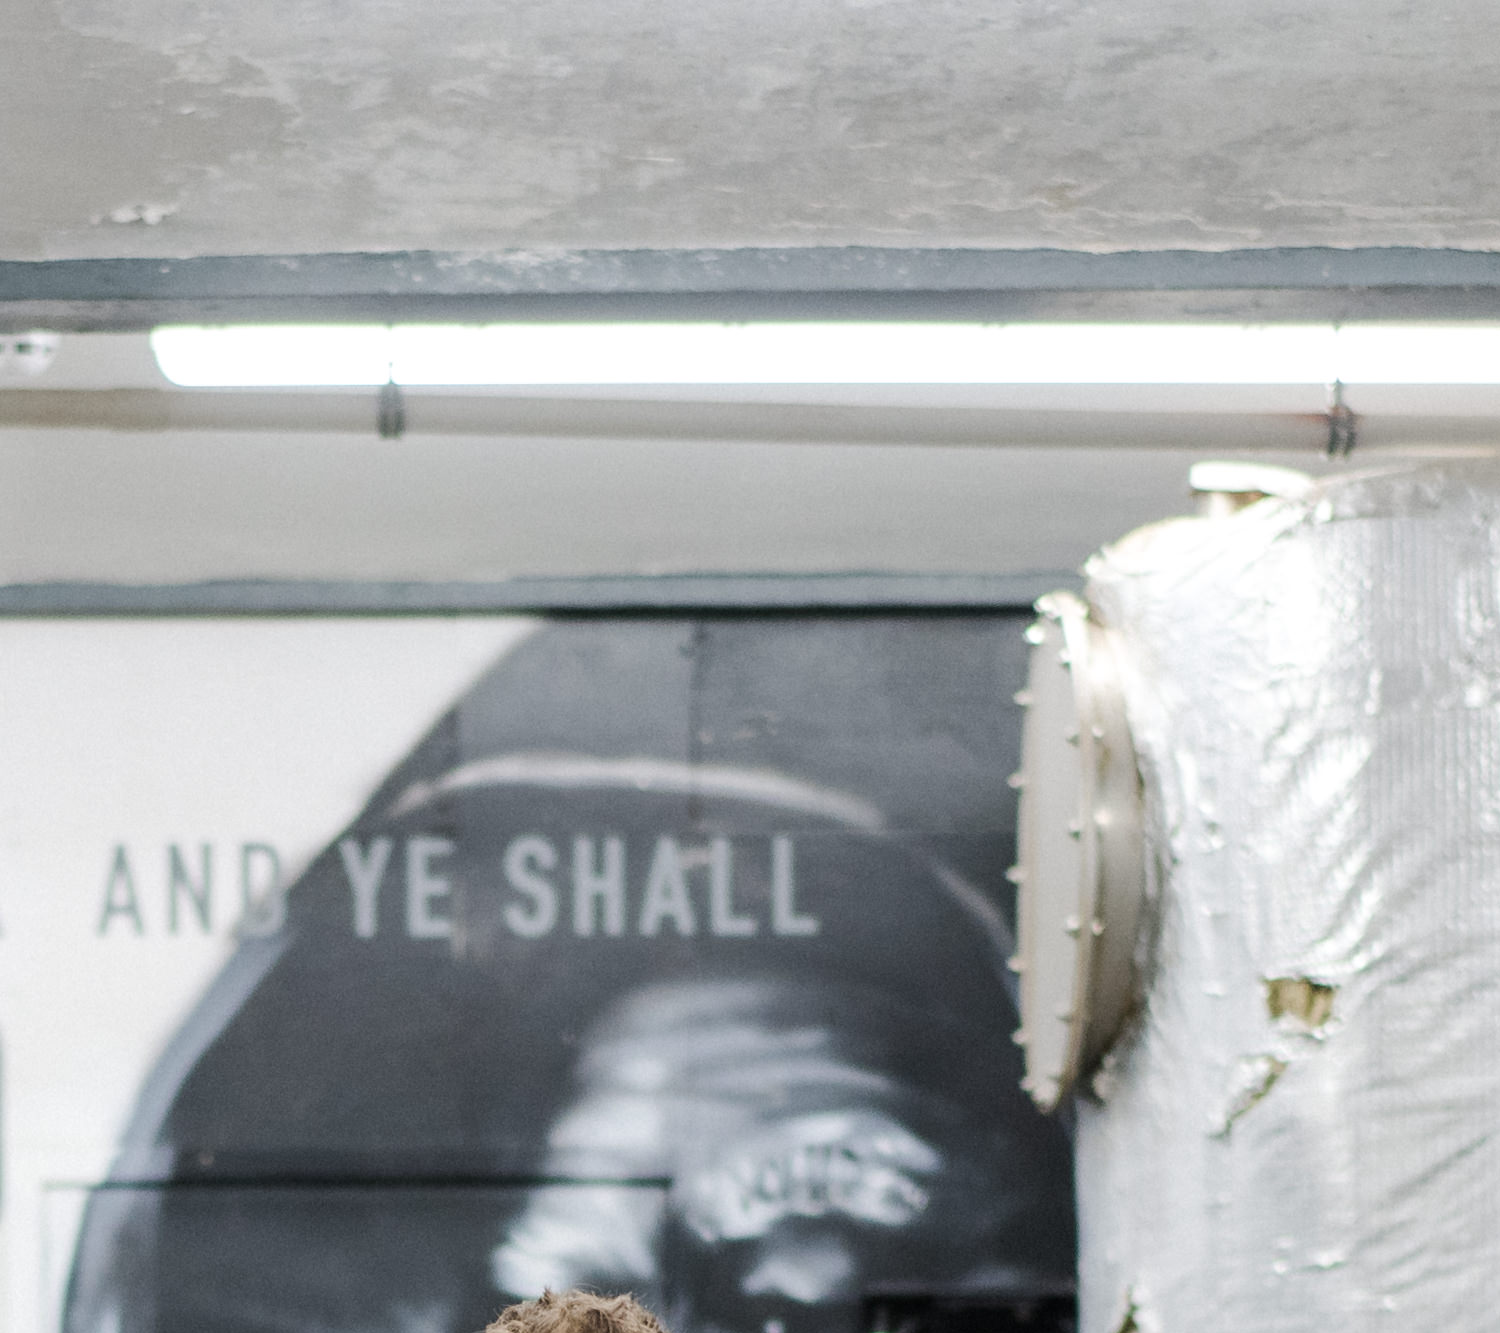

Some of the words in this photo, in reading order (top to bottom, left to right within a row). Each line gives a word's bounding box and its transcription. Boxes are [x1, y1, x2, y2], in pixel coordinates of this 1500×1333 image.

[96, 841, 288, 938] AND
[338, 835, 454, 940] YE
[502, 833, 821, 939] SHALL
